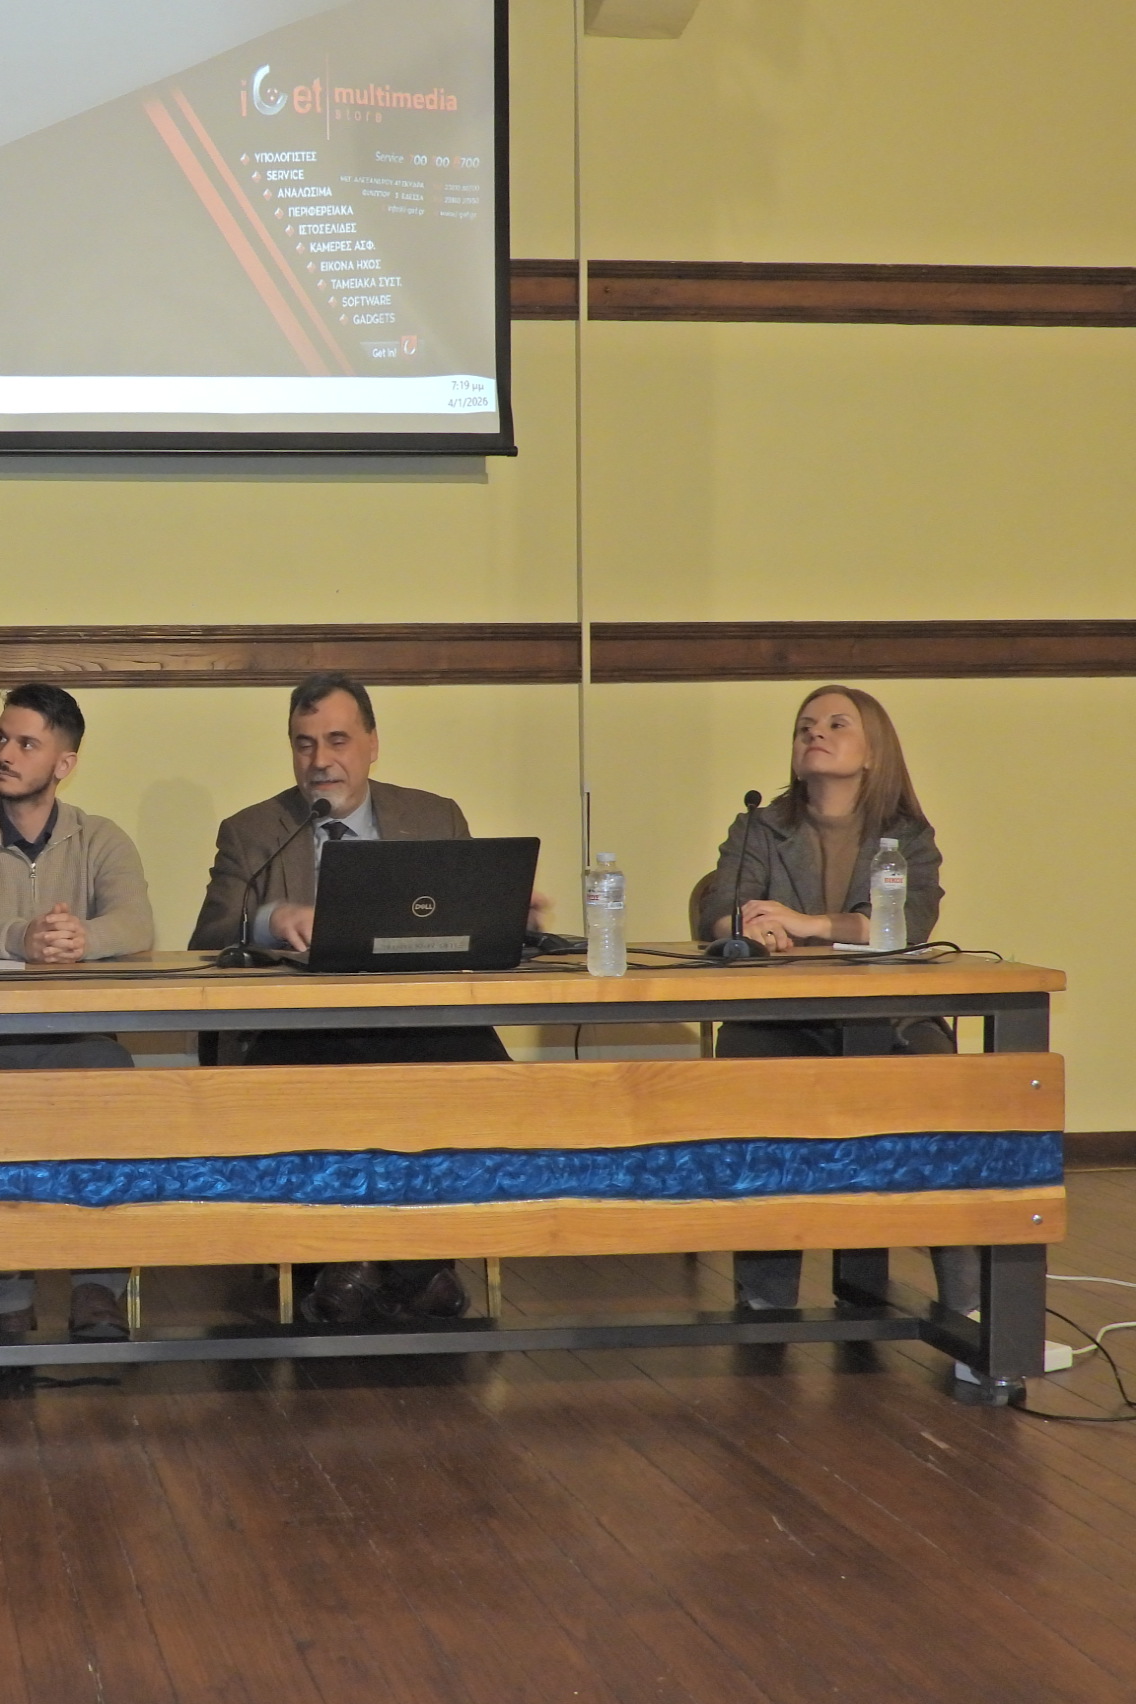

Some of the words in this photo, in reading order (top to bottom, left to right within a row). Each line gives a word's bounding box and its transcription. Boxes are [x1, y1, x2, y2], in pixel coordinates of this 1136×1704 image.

[334, 83, 458, 111] multimedia
[334, 109, 383, 123] store
[254, 151, 317, 163] ΥΠΟΛΟΓΙΣΤΕΣ
[375, 151, 404, 164] Service
[266, 169, 304, 181] SERVICE
[277, 186, 333, 199] ΑΝΑΛΩΣΙΜΑ
[288, 205, 354, 217] ΠΕΡΙΦΕΡΕΙΑΚΑ
[298, 222, 357, 235] ΙΣΤΟΣΕΛΙΔΕΣ
[309, 241, 352, 253] ΚΑΜΕΡΕΣ
[354, 239, 376, 251] ΑΣΦ.
[320, 260, 354, 272] ΕΙΚΟΝΑ
[356, 259, 382, 270] ΗΧΟΣ
[331, 278, 376, 290] ΤΑΜΕΙΑΚΑ
[378, 277, 402, 287] ΣΥΣΤ.
[342, 294, 392, 307] SOFTWARE
[353, 312, 396, 325] GADGETS
[451, 380, 470, 390] 7:19
[448, 397, 489, 408] 4/1/2026
